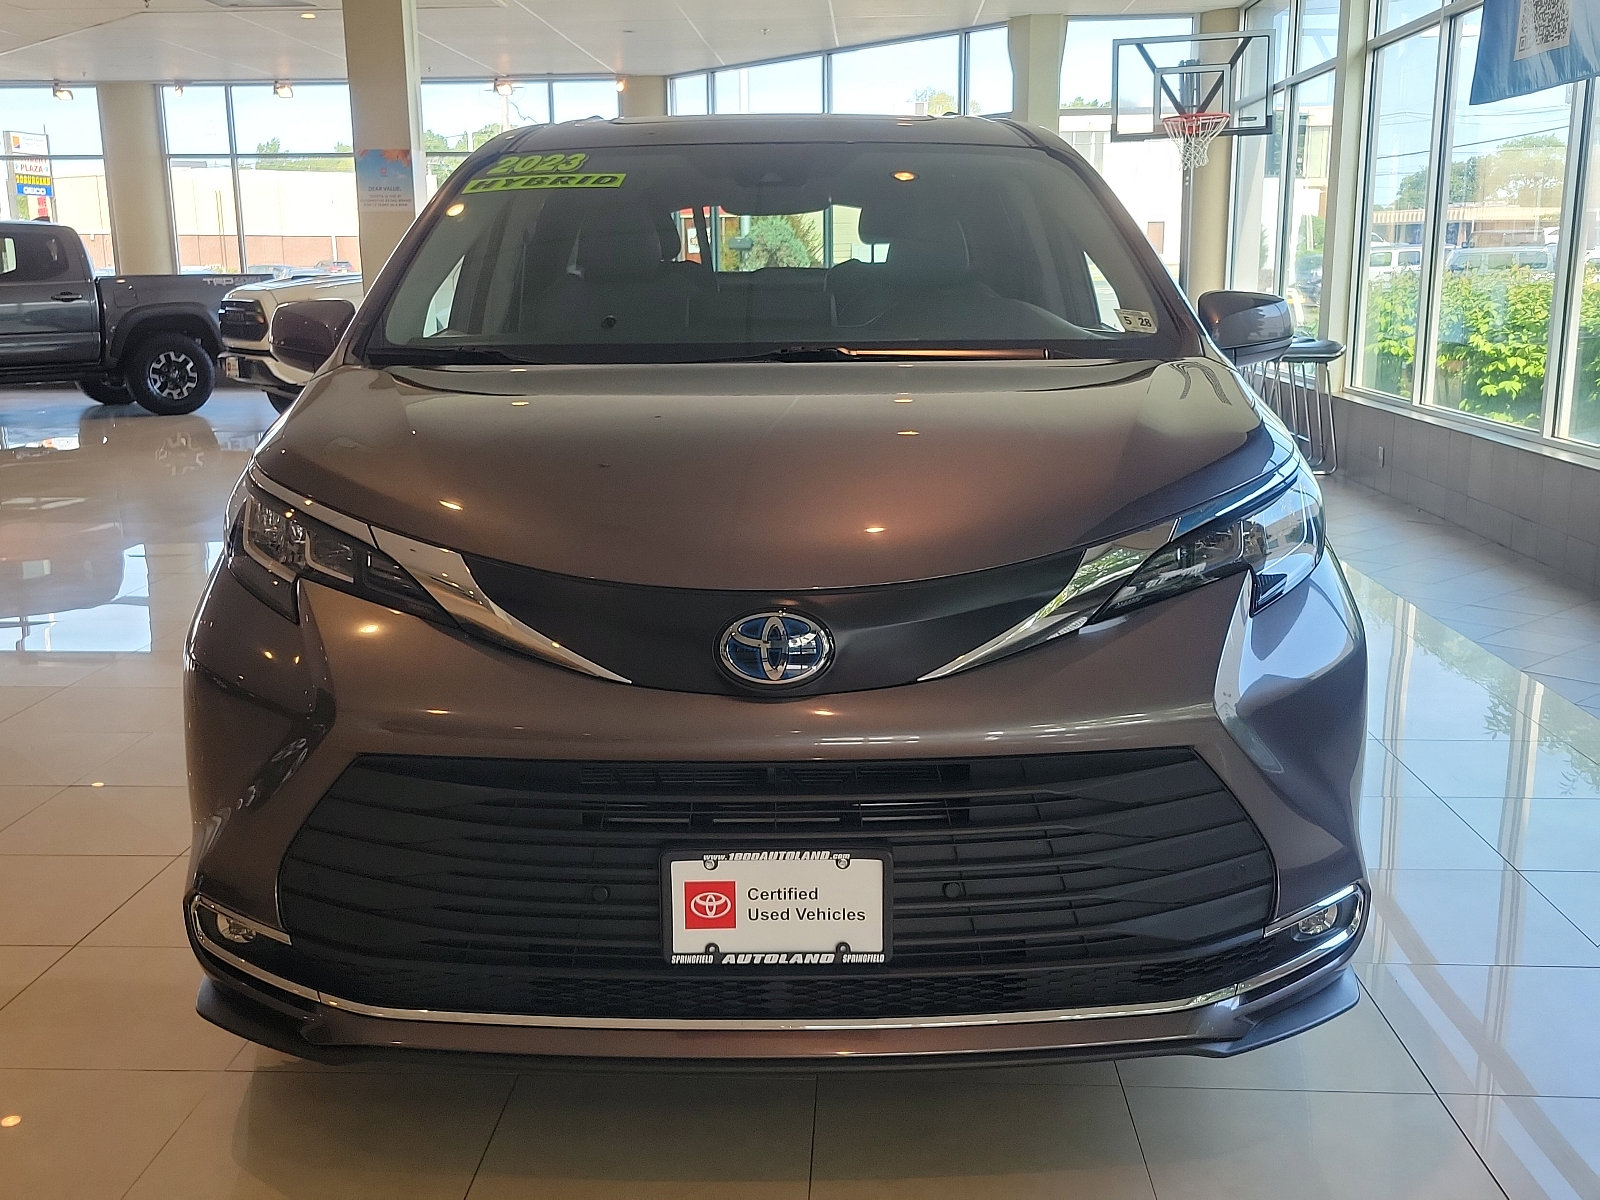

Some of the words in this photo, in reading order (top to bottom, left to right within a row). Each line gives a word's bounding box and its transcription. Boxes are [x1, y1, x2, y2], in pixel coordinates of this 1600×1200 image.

[20, 163, 44, 173] PLAZA
[486, 153, 589, 174] 2023
[469, 175, 619, 190] HYBRID
[23, 186, 47, 195] GEICO
[1123, 316, 1132, 325] 5
[1138, 317, 1152, 327] 28
[747, 887, 819, 900] Certified
[747, 908, 790, 921] Used
[796, 907, 866, 921] Vehicles
[671, 954, 714, 964] SPRINGFIELD
[721, 953, 836, 964] AUTOLAND
[842, 953, 885, 964] SPRINGFIELD
